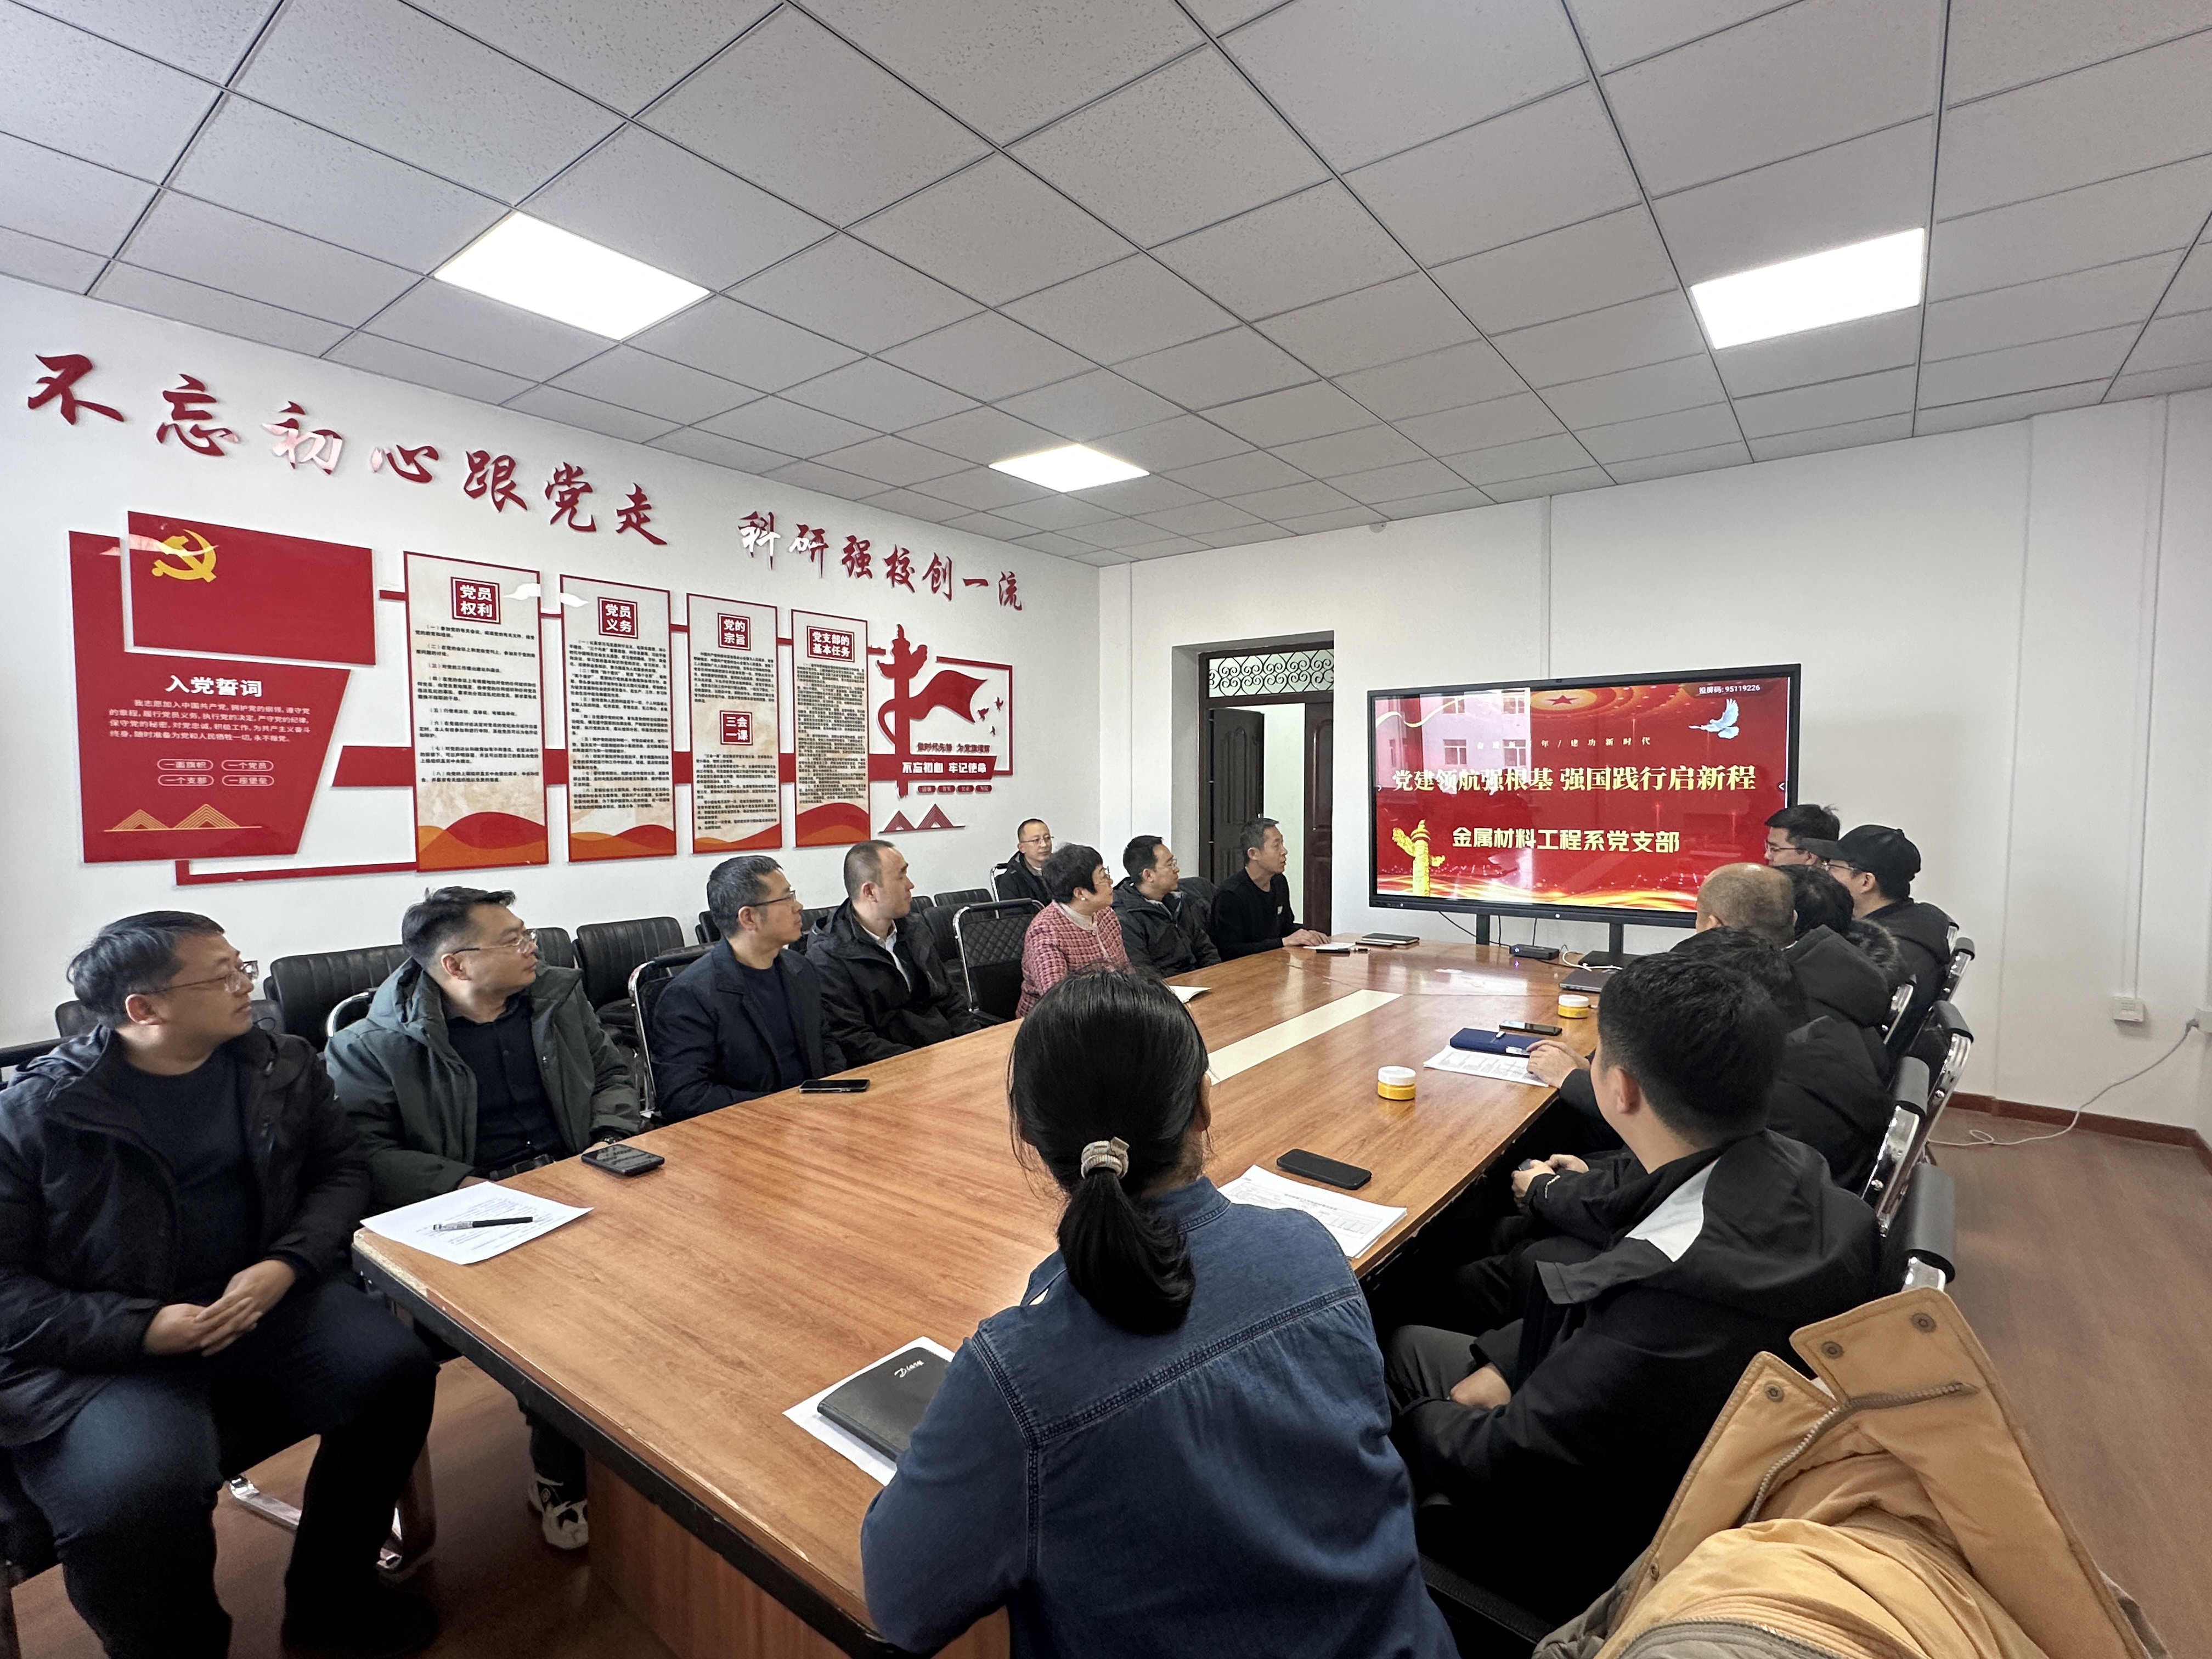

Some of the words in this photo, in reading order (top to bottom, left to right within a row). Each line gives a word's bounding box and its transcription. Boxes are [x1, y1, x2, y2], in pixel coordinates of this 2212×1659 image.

[28, 353, 668, 545] 不忘初心跟党走
[738, 511, 1023, 611] 科研强校创一流
[460, 584, 493, 602] 党员
[460, 601, 493, 618] 权利
[605, 603, 631, 618] 党员
[606, 619, 631, 633] 义务
[724, 619, 746, 632] 党的
[724, 632, 746, 645] 宗旨
[812, 631, 850, 646] 党支部的
[812, 643, 850, 657] 基本任务
[166, 675, 262, 697] 入党誓词
[726, 716, 747, 727] 三会
[726, 729, 748, 741] 一课
[902, 761, 944, 774] 不忘初心
[948, 762, 986, 774] 牢记使命
[165, 776, 207, 785] 一个支部
[1392, 768, 1554, 792] 党建领航强根基
[1560, 764, 1756, 792] 强国践行启新程
[1452, 827, 1680, 853] 金属材料工程系党支部
